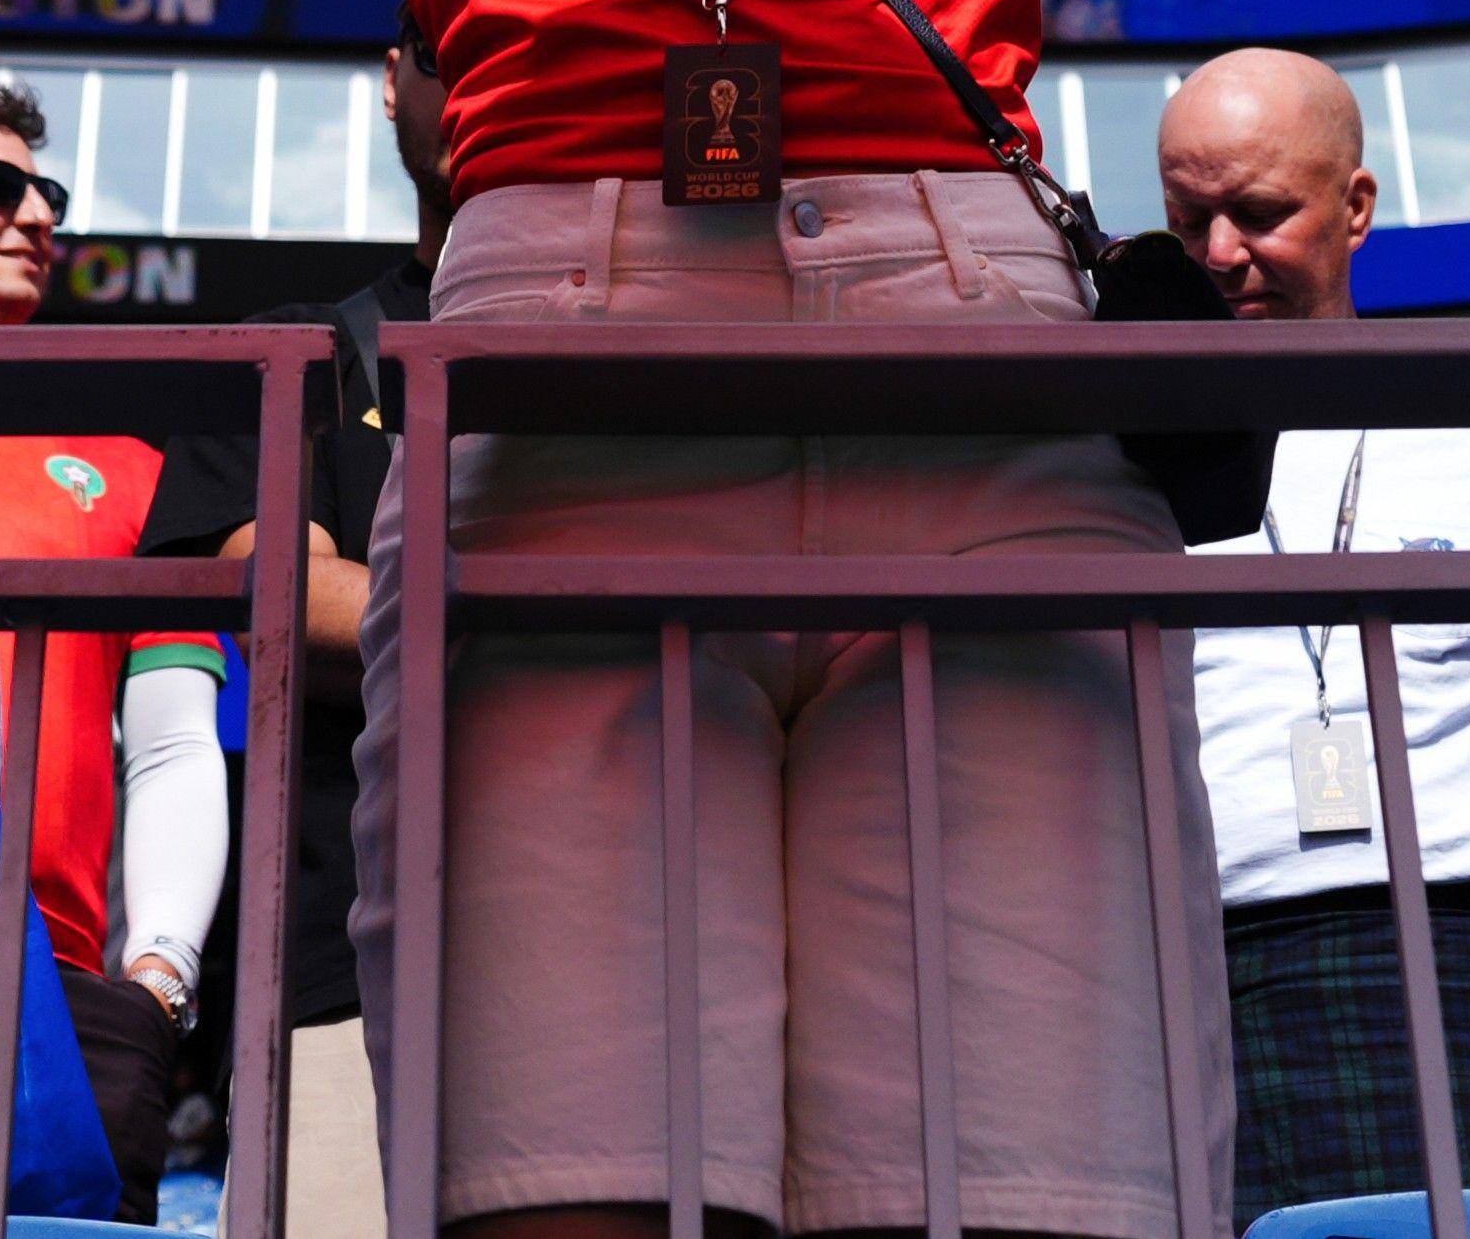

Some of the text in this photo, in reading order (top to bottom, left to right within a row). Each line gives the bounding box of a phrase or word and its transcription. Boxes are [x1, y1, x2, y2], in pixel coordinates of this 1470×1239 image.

[705, 147, 740, 161] FIFA
[685, 182, 761, 199] 2026
[53, 243, 198, 306] ON
